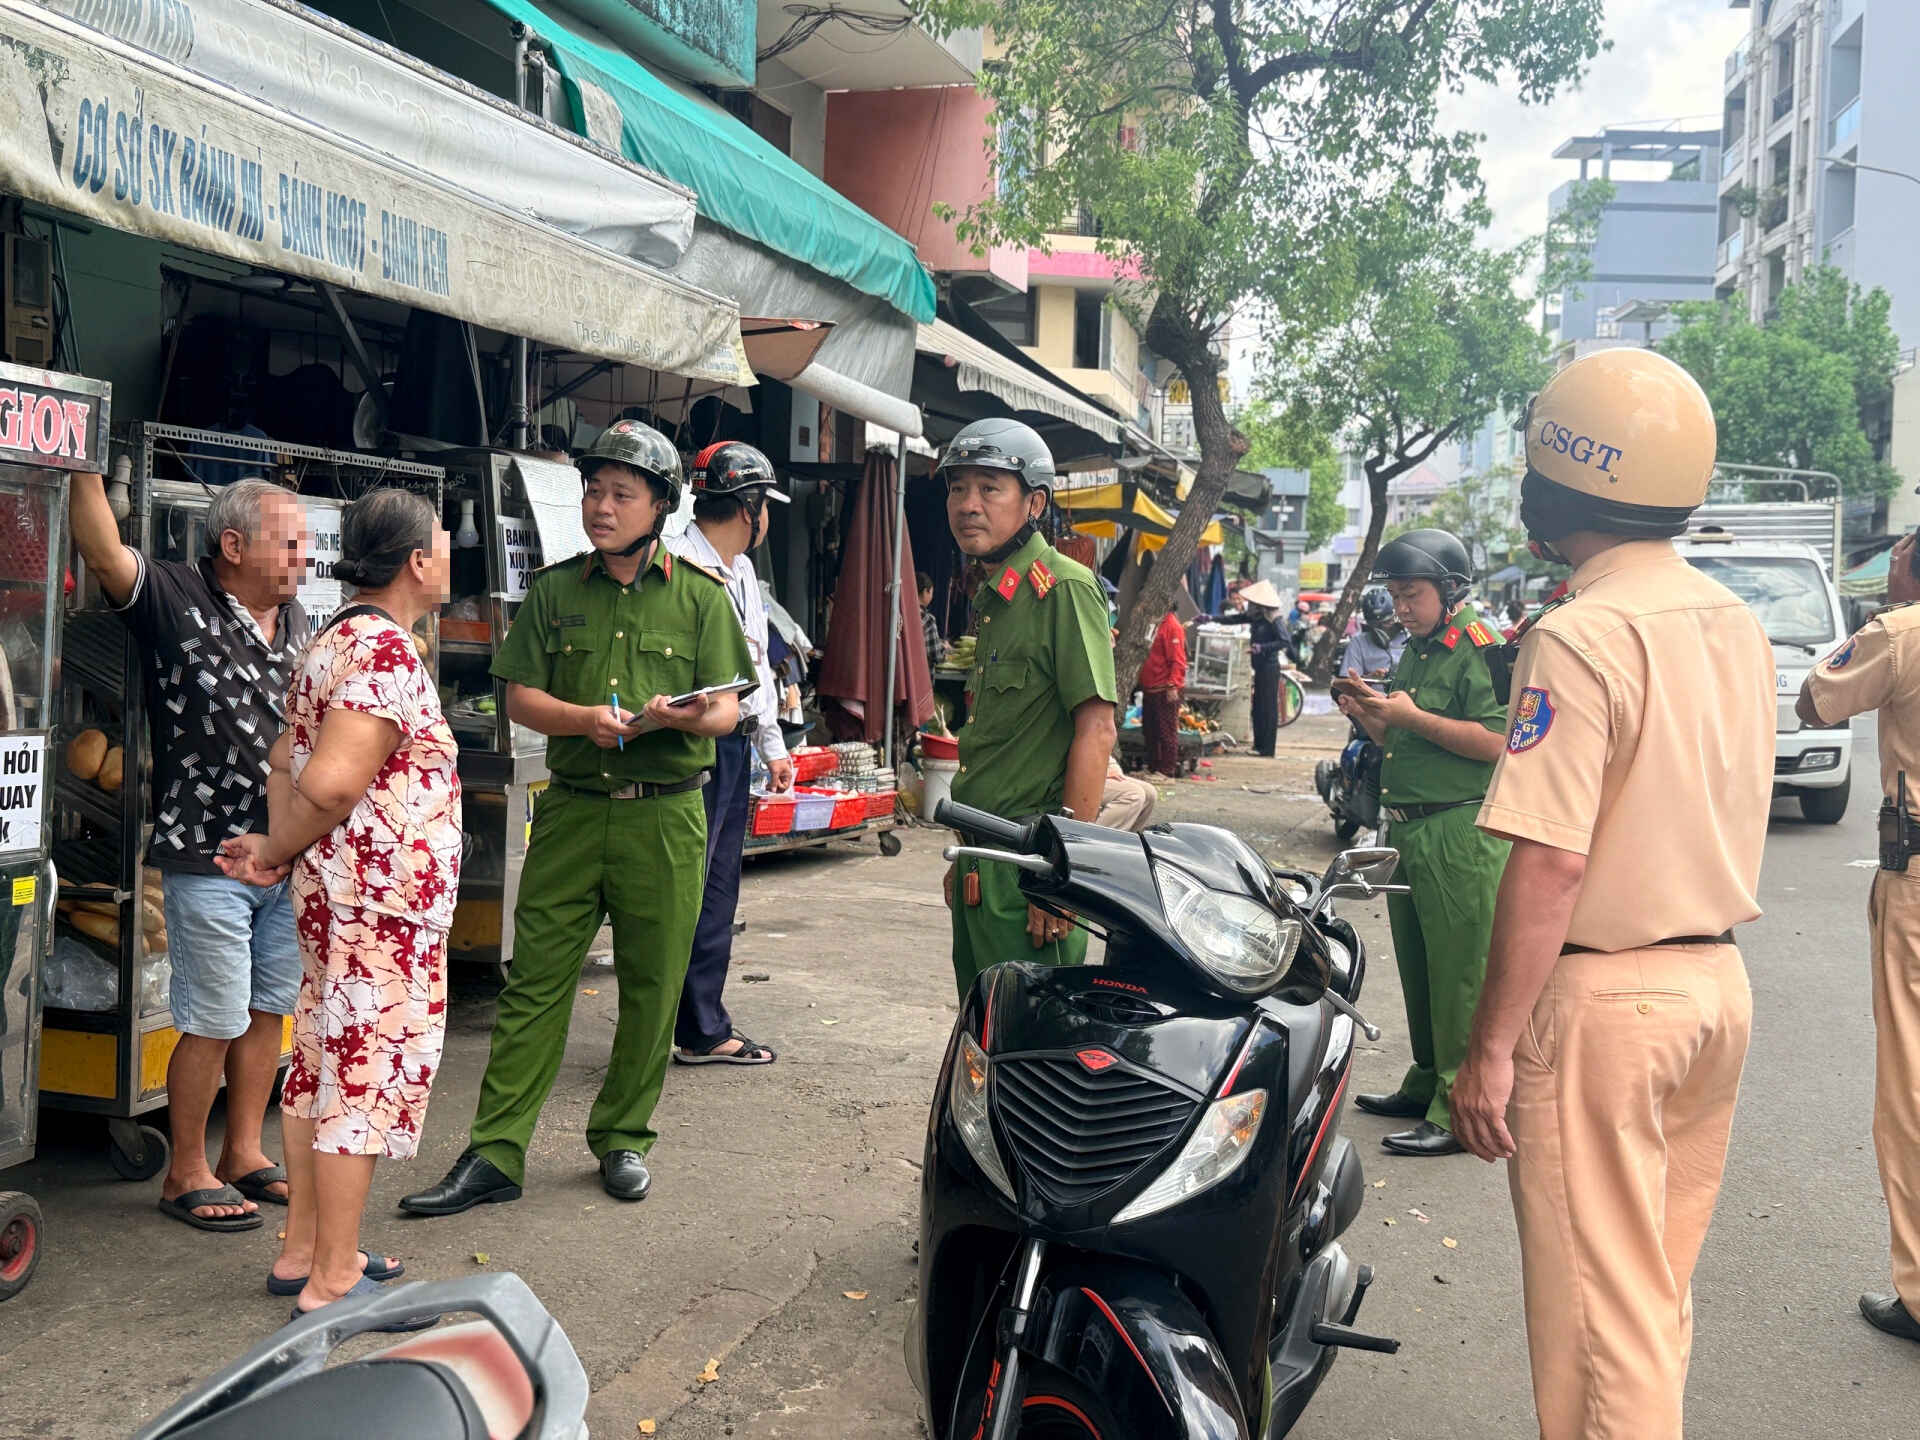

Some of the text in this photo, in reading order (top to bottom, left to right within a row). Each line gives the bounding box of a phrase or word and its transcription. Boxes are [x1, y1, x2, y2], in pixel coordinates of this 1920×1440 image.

[73, 96, 108, 193] CƠ
[148, 123, 178, 215] SX
[179, 124, 235, 233] BÁNH
[236, 147, 265, 242] MÌ
[279, 161, 324, 260] BÁNH
[574, 320, 601, 344] The
[1540, 420, 1623, 473] CSGT
[3, 741, 39, 775] HỎI
[1092, 977, 1149, 994] HONDA
